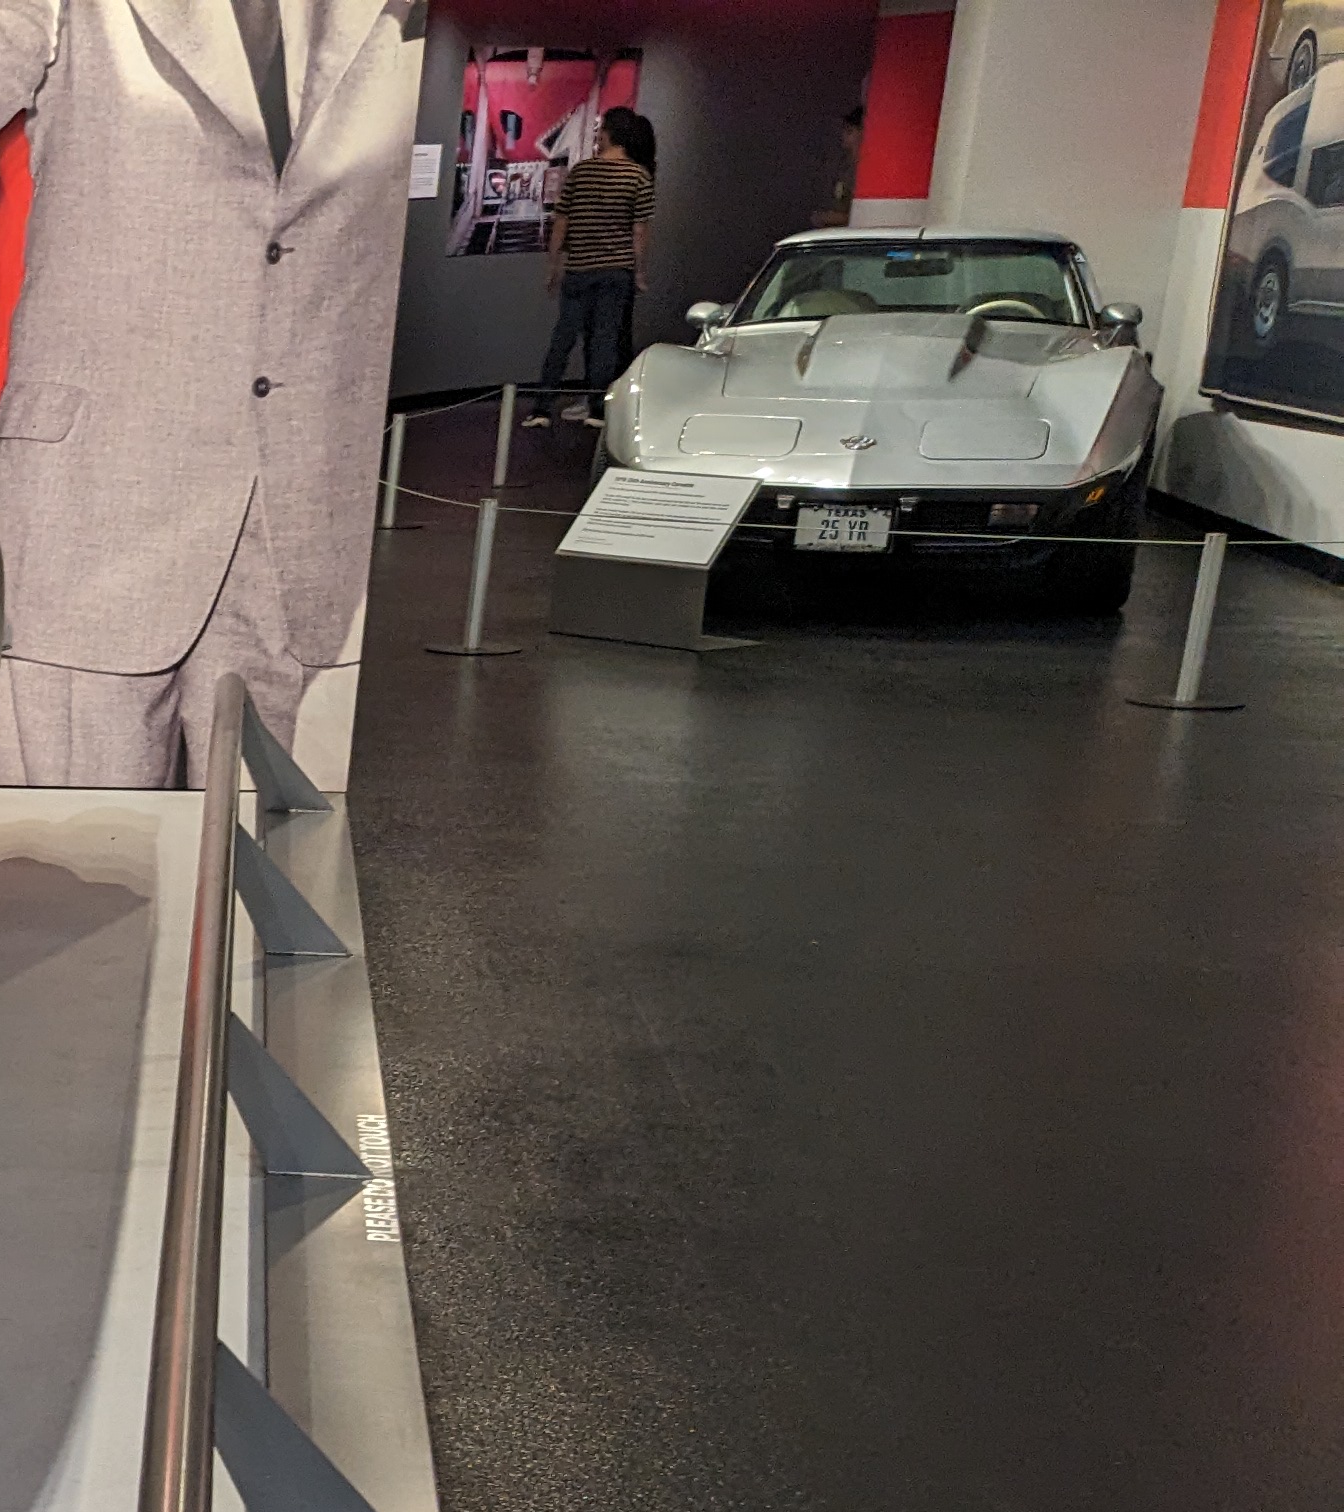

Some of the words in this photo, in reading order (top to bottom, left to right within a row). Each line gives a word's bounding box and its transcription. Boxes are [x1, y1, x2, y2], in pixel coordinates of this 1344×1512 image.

[826, 508, 867, 518] TEXAS
[818, 519, 840, 540] 25
[848, 520, 870, 541] YR
[356, 1114, 390, 1150] TOUCH
[362, 1179, 395, 1196] DO
[363, 1198, 401, 1242] PLEASE
